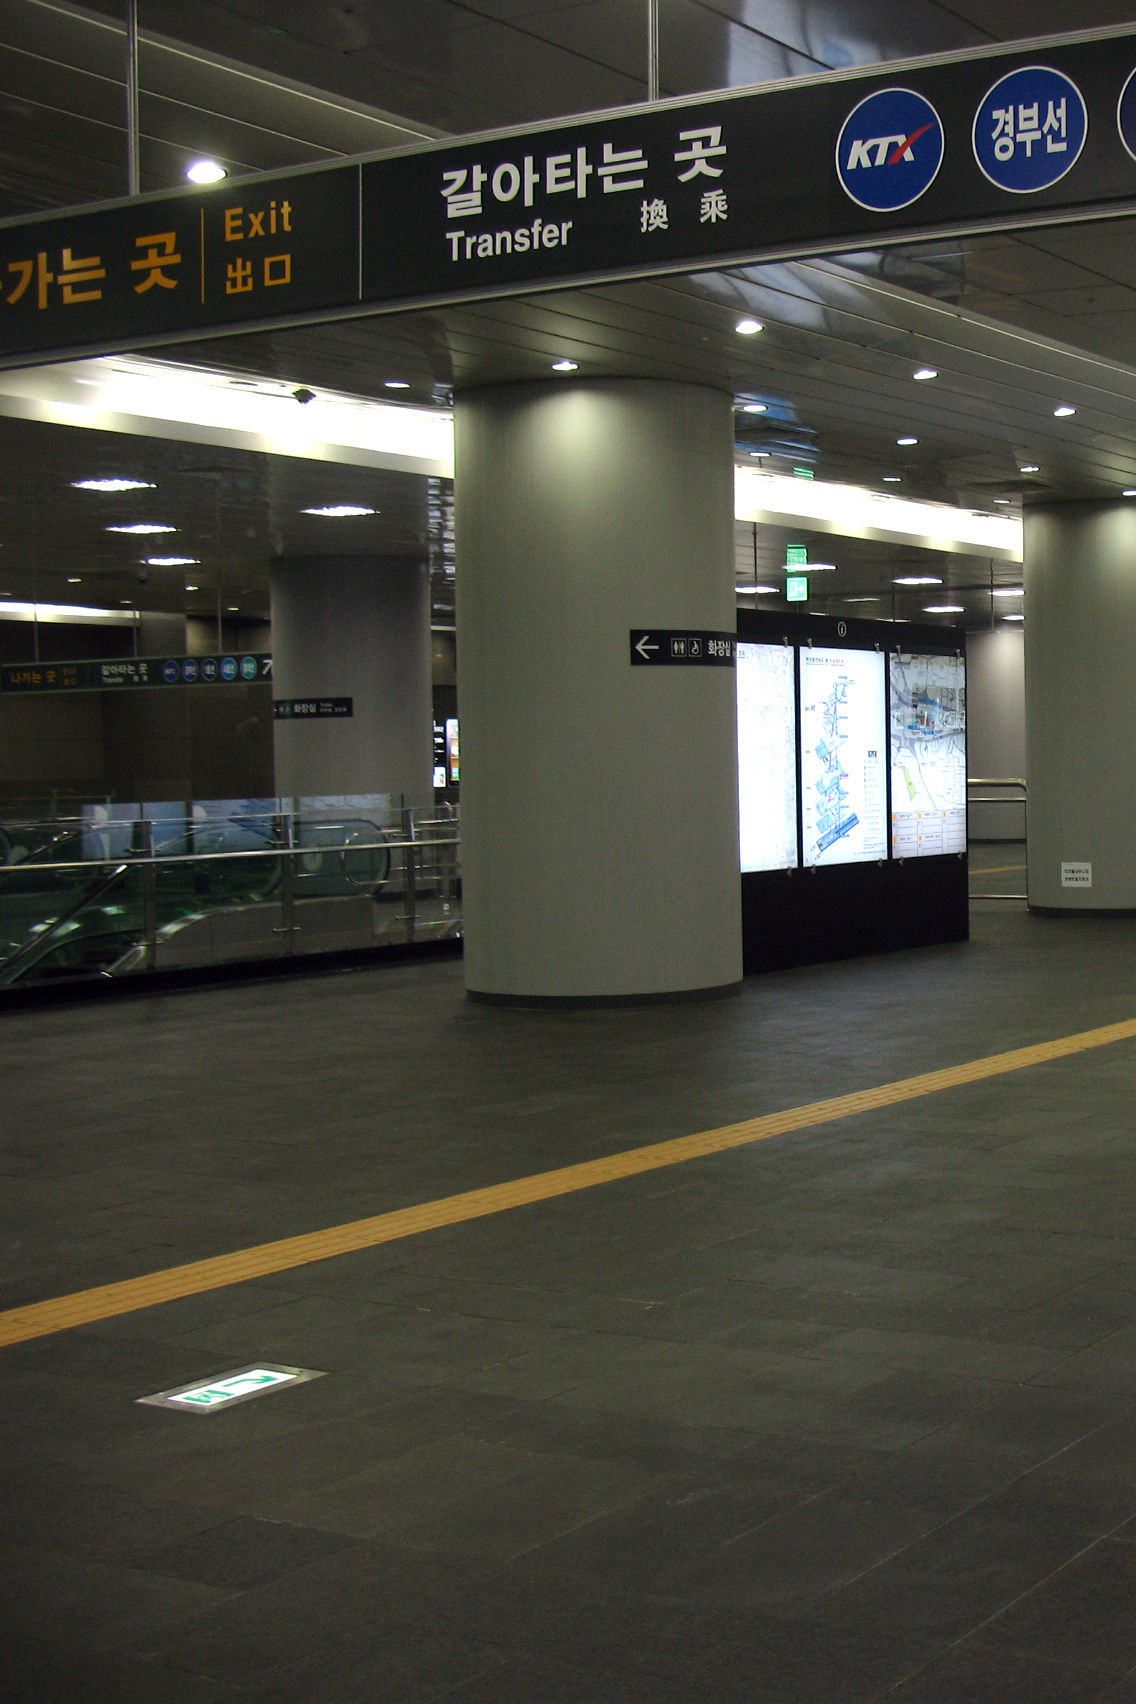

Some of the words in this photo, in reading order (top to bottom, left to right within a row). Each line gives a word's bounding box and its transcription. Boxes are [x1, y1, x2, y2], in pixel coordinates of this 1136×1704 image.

[846, 125, 932, 170] KTX
[991, 98, 1067, 161] 경부선
[440, 143, 648, 218] 갈아타는
[674, 126, 727, 183] 곳
[224, 200, 292, 242] Exit
[446, 218, 573, 261] Transfer
[0, 248, 106, 309] 가는
[131, 231, 181, 294] 곳
[226, 254, 291, 294] 出口
[707, 640, 731, 657] 화장실
